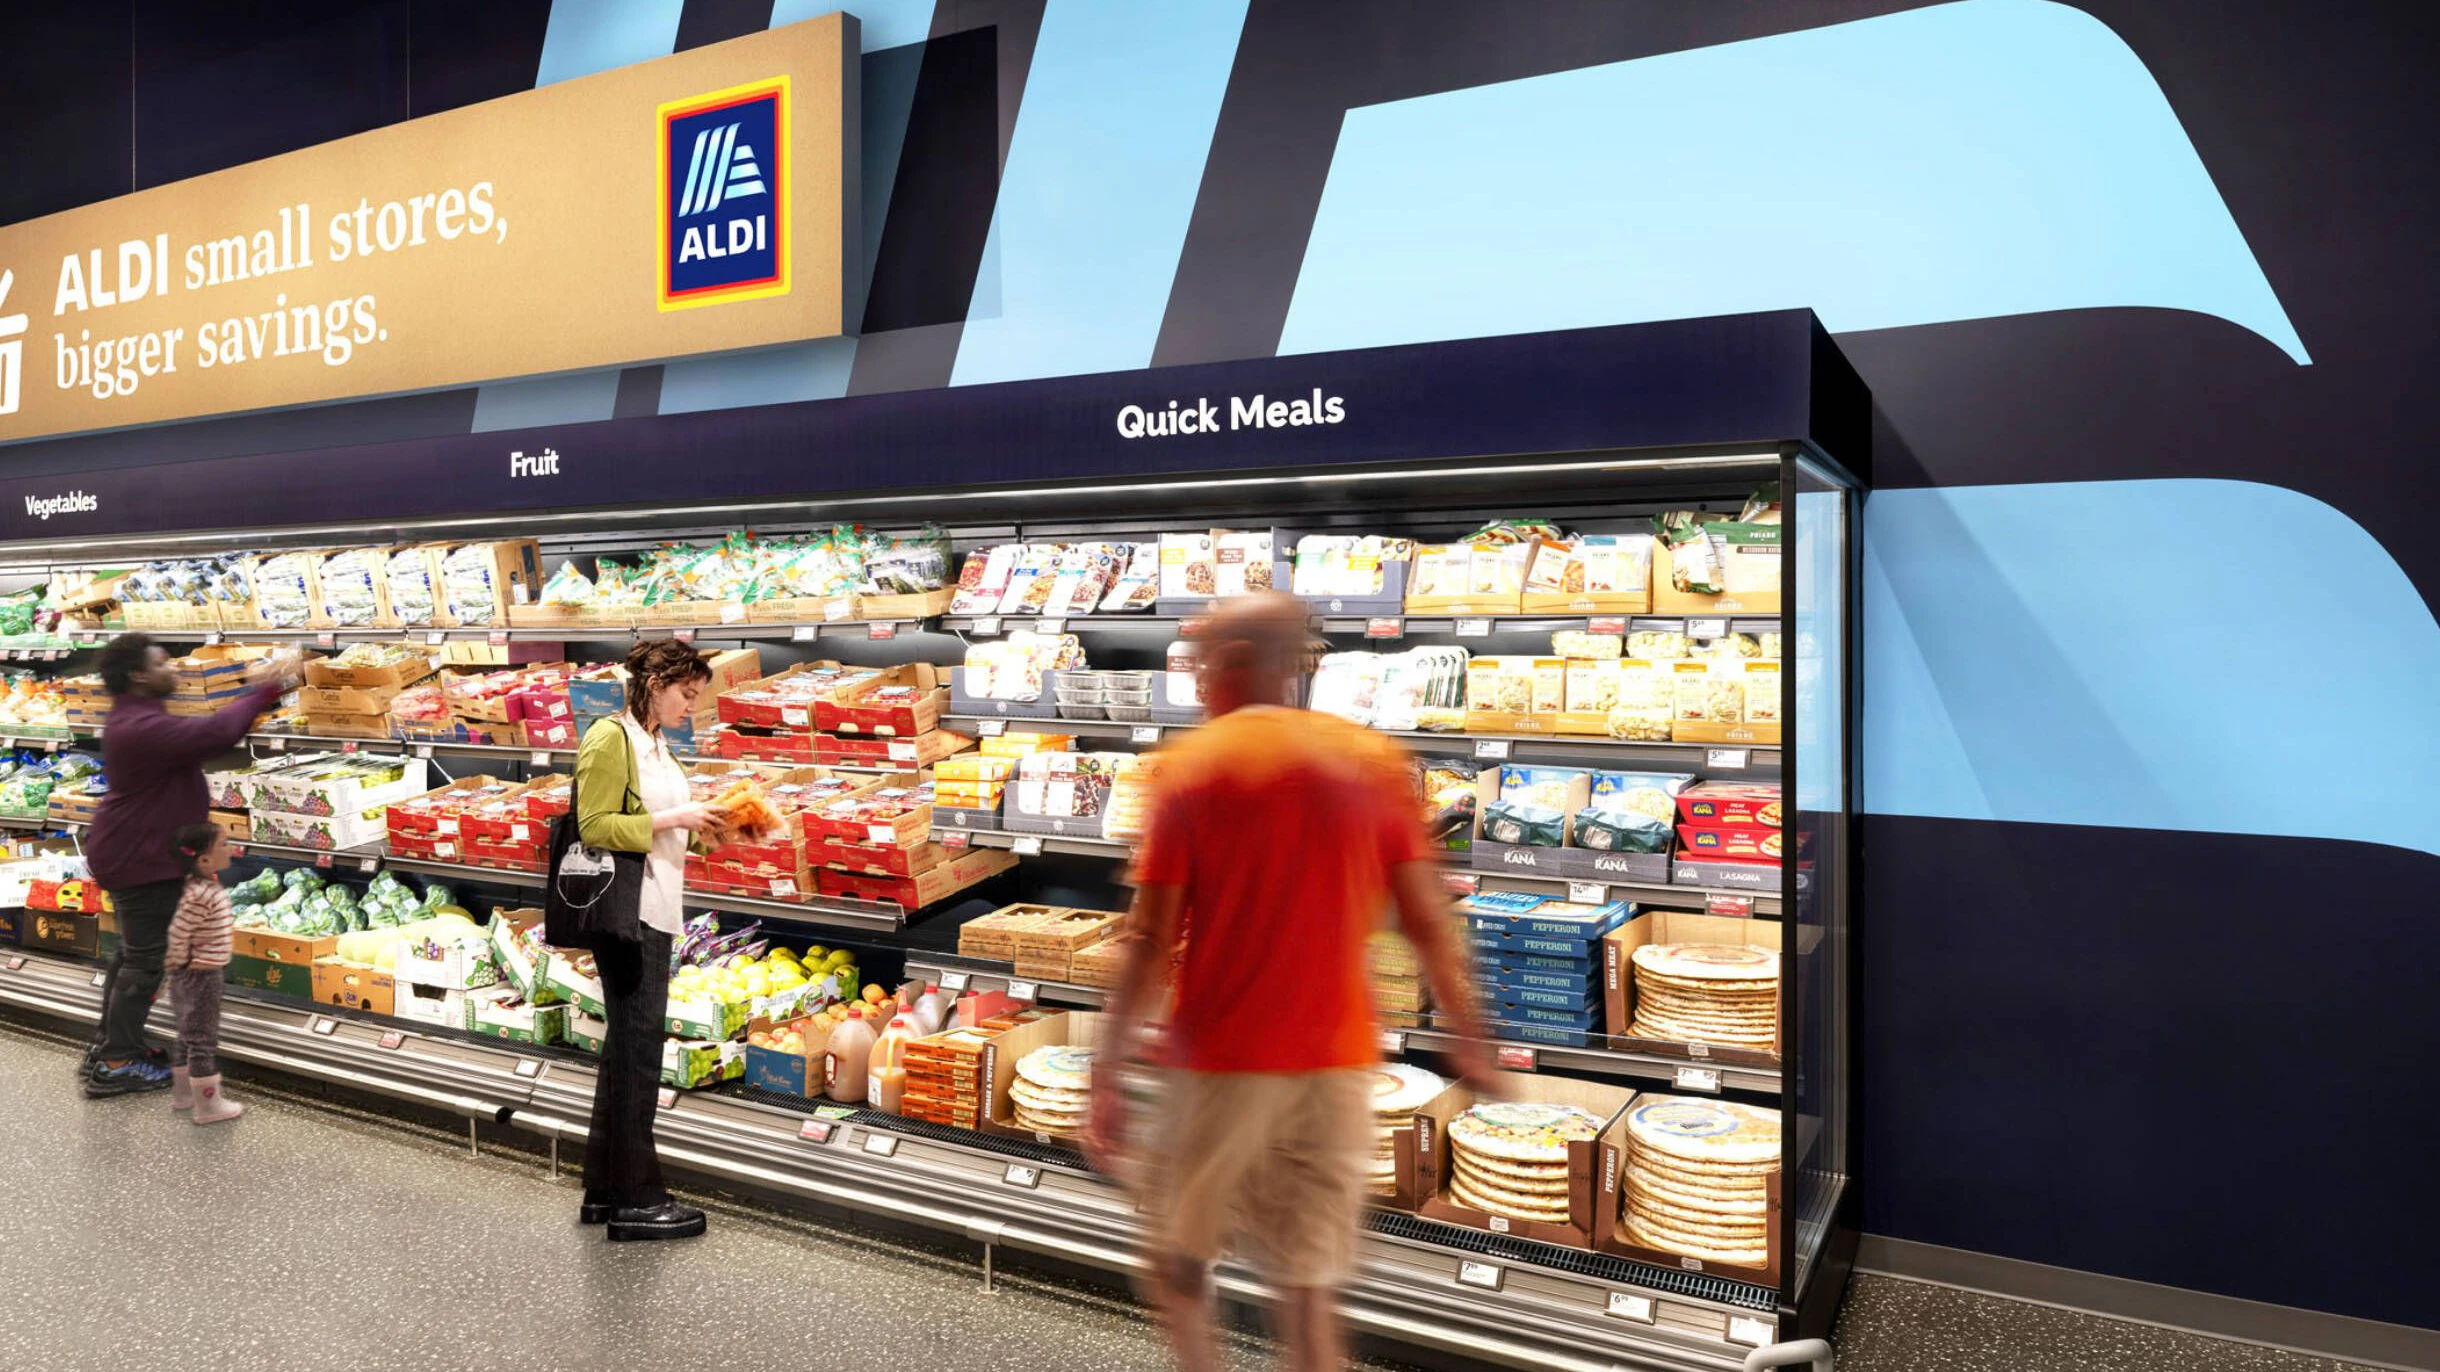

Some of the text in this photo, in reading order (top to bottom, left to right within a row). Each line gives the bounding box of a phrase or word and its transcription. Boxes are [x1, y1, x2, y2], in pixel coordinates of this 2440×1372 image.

[55, 181, 508, 316] ALDI small stores,
[679, 213, 766, 264] ALDI
[55, 294, 388, 399] bigger savings.
[1116, 387, 1346, 439] Quick Meals
[510, 448, 560, 478] Fruit
[24, 489, 98, 521] Vegetables
[1720, 871, 1761, 882] LASAGNA
[1532, 922, 1581, 934] PEPPERONI
[1524, 939, 1572, 952] PEPPERONI
[1608, 945, 1616, 967] MEAT
[1526, 956, 1575, 969] PEPPERONI
[1523, 974, 1571, 987] PEPPERONI
[1521, 992, 1569, 1005] PEPPERONI
[1527, 1010, 1575, 1023] PEPPERONI
[1522, 1027, 1570, 1041] PEPPERONI
[1420, 1118, 1430, 1153] SUPREME
[1604, 1148, 1615, 1193] PEPPERONI
